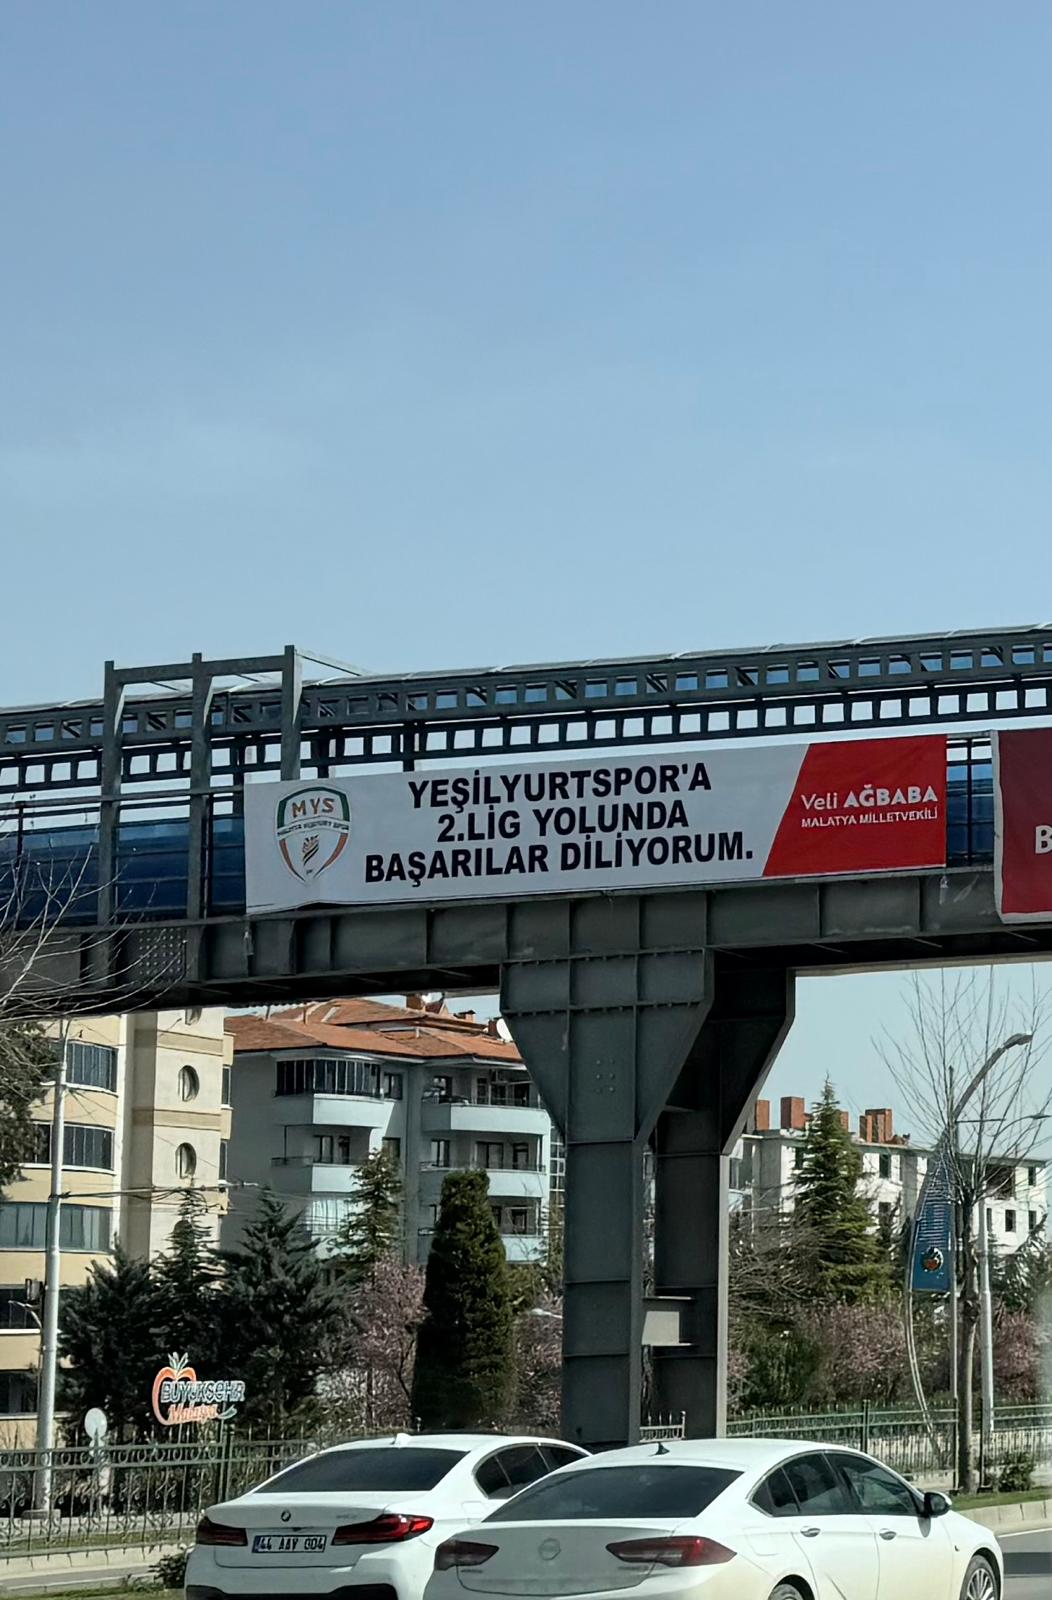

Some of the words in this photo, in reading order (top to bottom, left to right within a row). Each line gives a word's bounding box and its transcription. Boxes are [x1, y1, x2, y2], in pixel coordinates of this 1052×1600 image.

[408, 763, 711, 815] YEŞİLYURTSPOR'A
[801, 792, 838, 810] Veli
[843, 784, 938, 808] AĞBABA
[291, 798, 335, 818] MYS
[437, 804, 520, 843] 2.LİG
[530, 799, 690, 837] YOLUNDA
[801, 815, 857, 828] MALATYA
[859, 806, 938, 825] MİLLETVEKİLİ
[366, 844, 550, 888] BAŞARILAR
[561, 831, 753, 872] DİLİYORUM.
